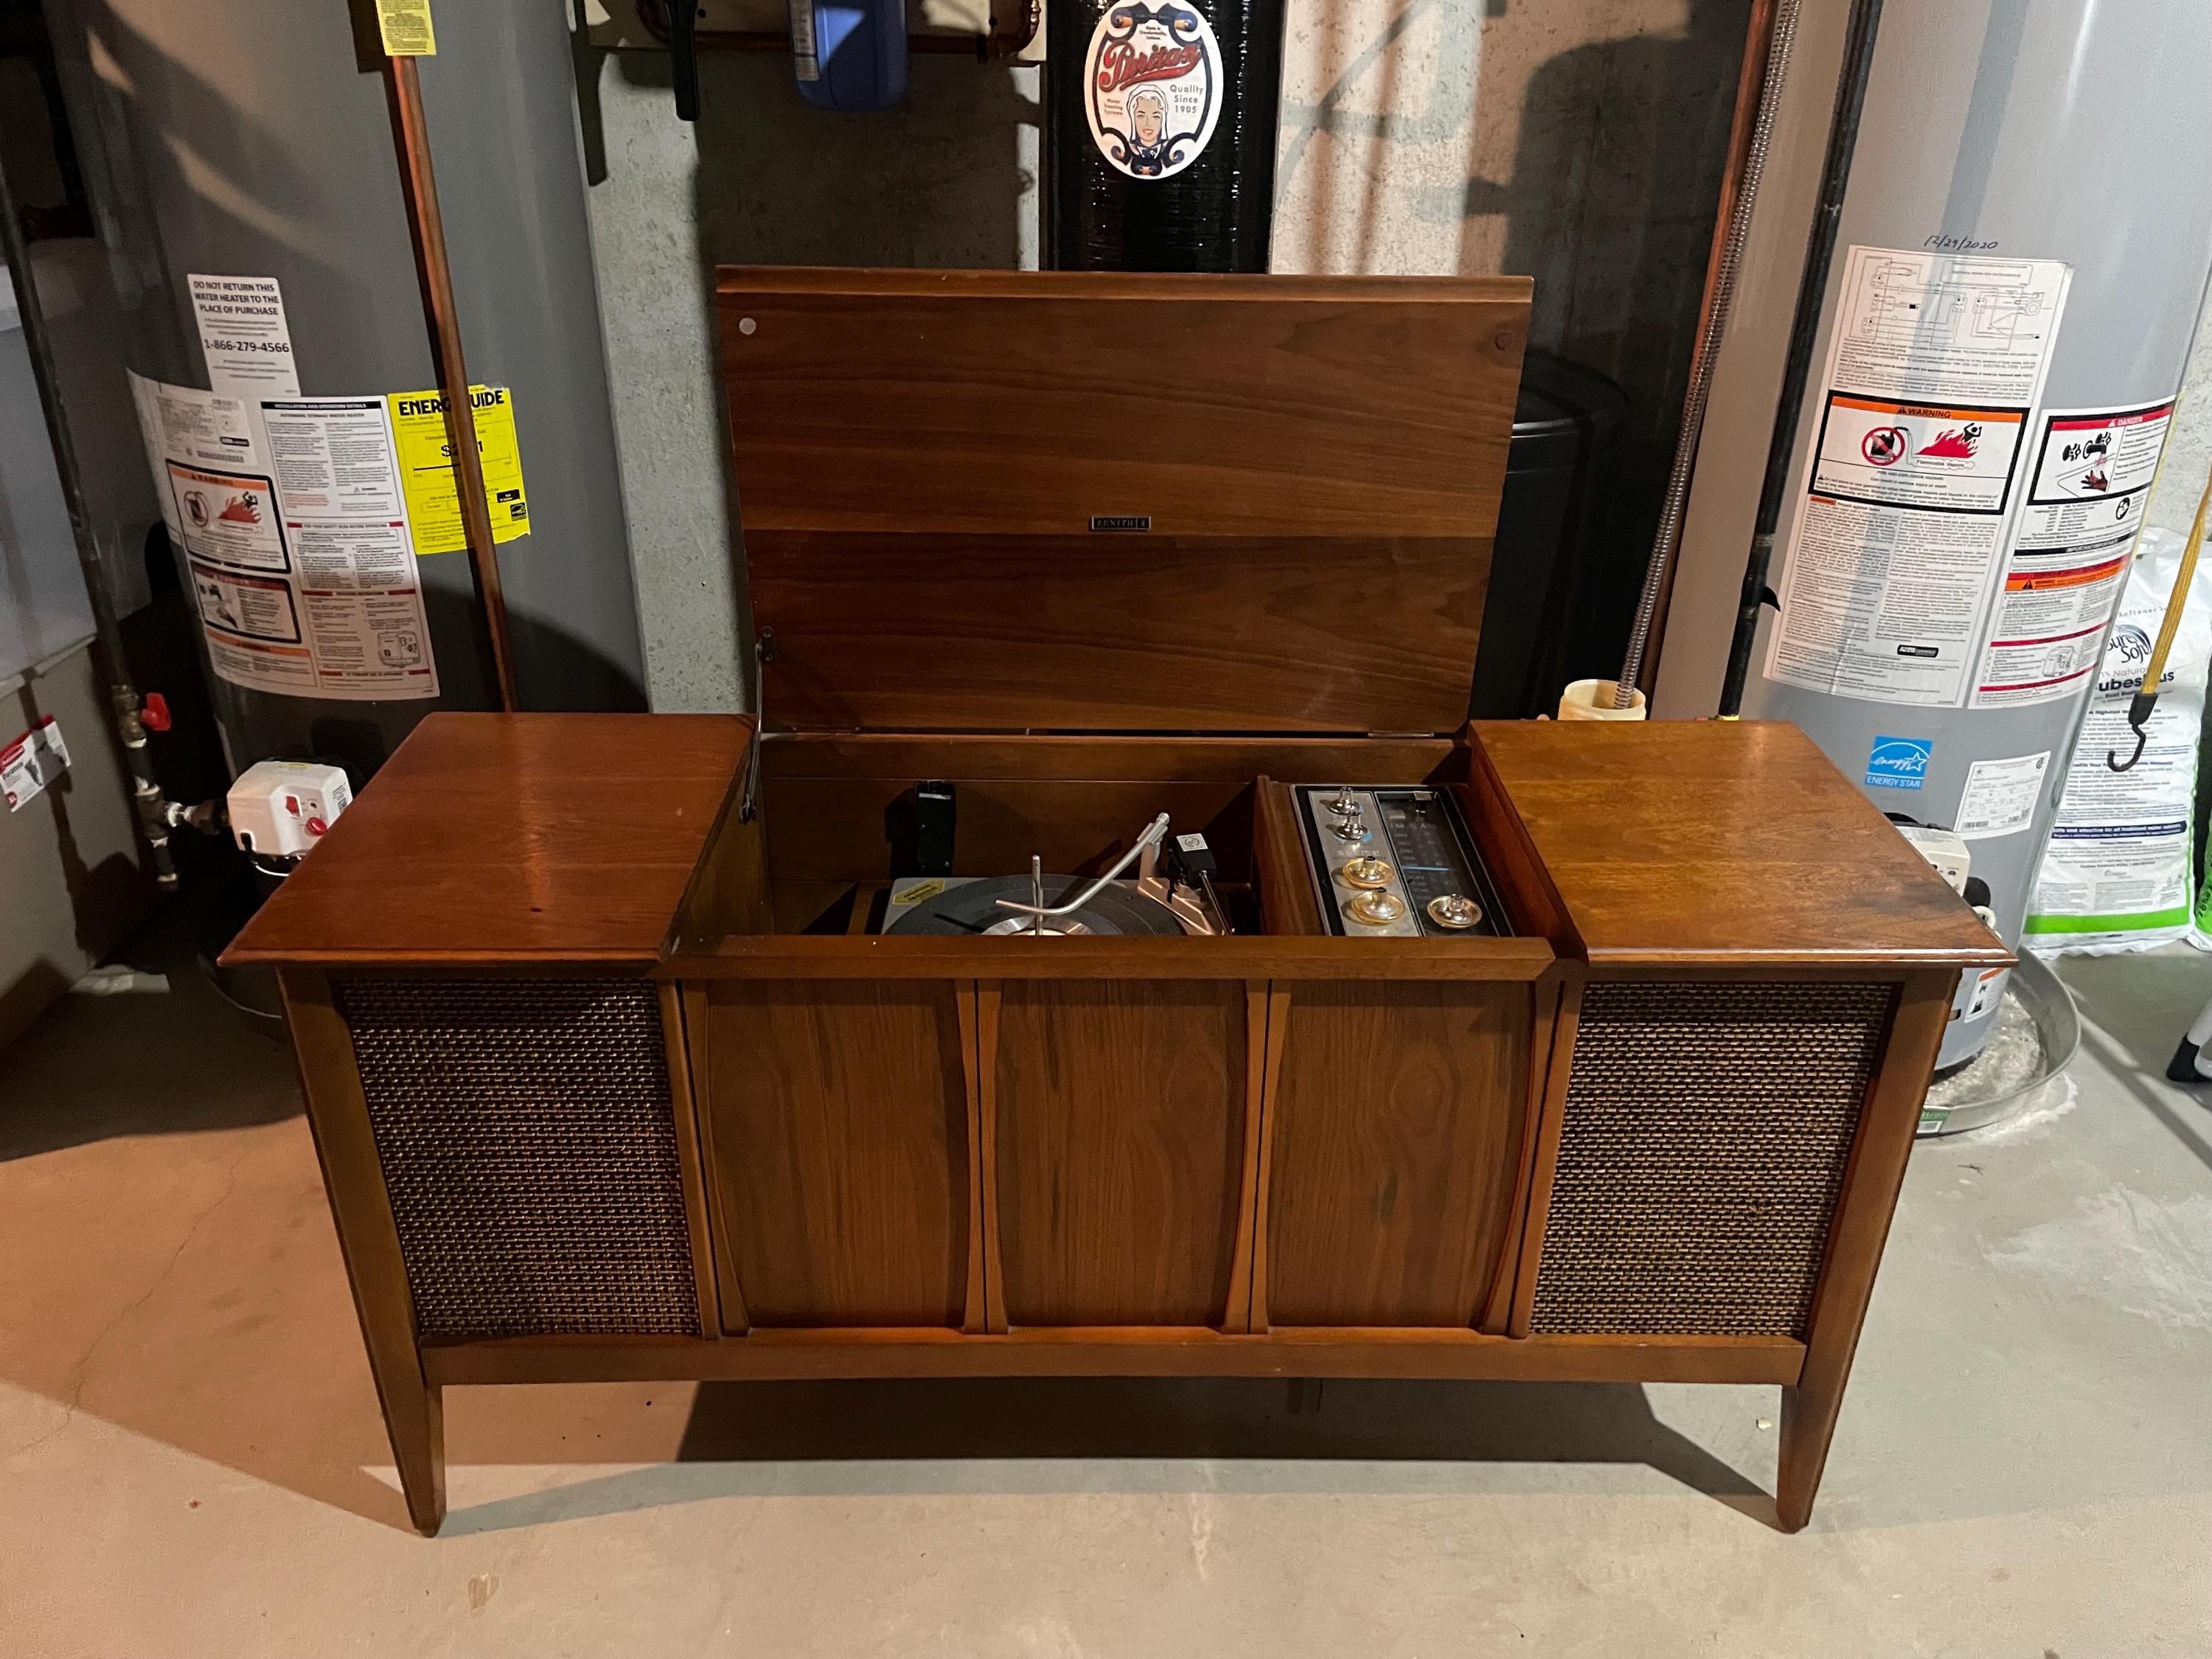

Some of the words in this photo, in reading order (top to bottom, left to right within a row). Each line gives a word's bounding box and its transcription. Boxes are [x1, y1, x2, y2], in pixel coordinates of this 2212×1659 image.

[1169, 84, 1203, 95] Quality
[1174, 95, 1198, 103] Since
[1175, 105, 1197, 114] 1905
[1924, 234, 1998, 251] 12/29/2020
[206, 282, 220, 290] NOT
[223, 283, 254, 291] RETURN
[195, 292, 218, 301] WATER
[221, 294, 249, 303] HEATER
[262, 296, 279, 304] THE
[199, 304, 221, 313] PLACE
[235, 307, 279, 316] PURCHASE
[204, 339, 289, 352] 1-866-279-4566
[1907, 408, 1951, 419] WARNING
[2117, 416, 2143, 426] DANGER
[2096, 677, 2142, 692] ubes
[1867, 776, 1898, 786] ENERGY
[1899, 779, 1921, 788] STAR
